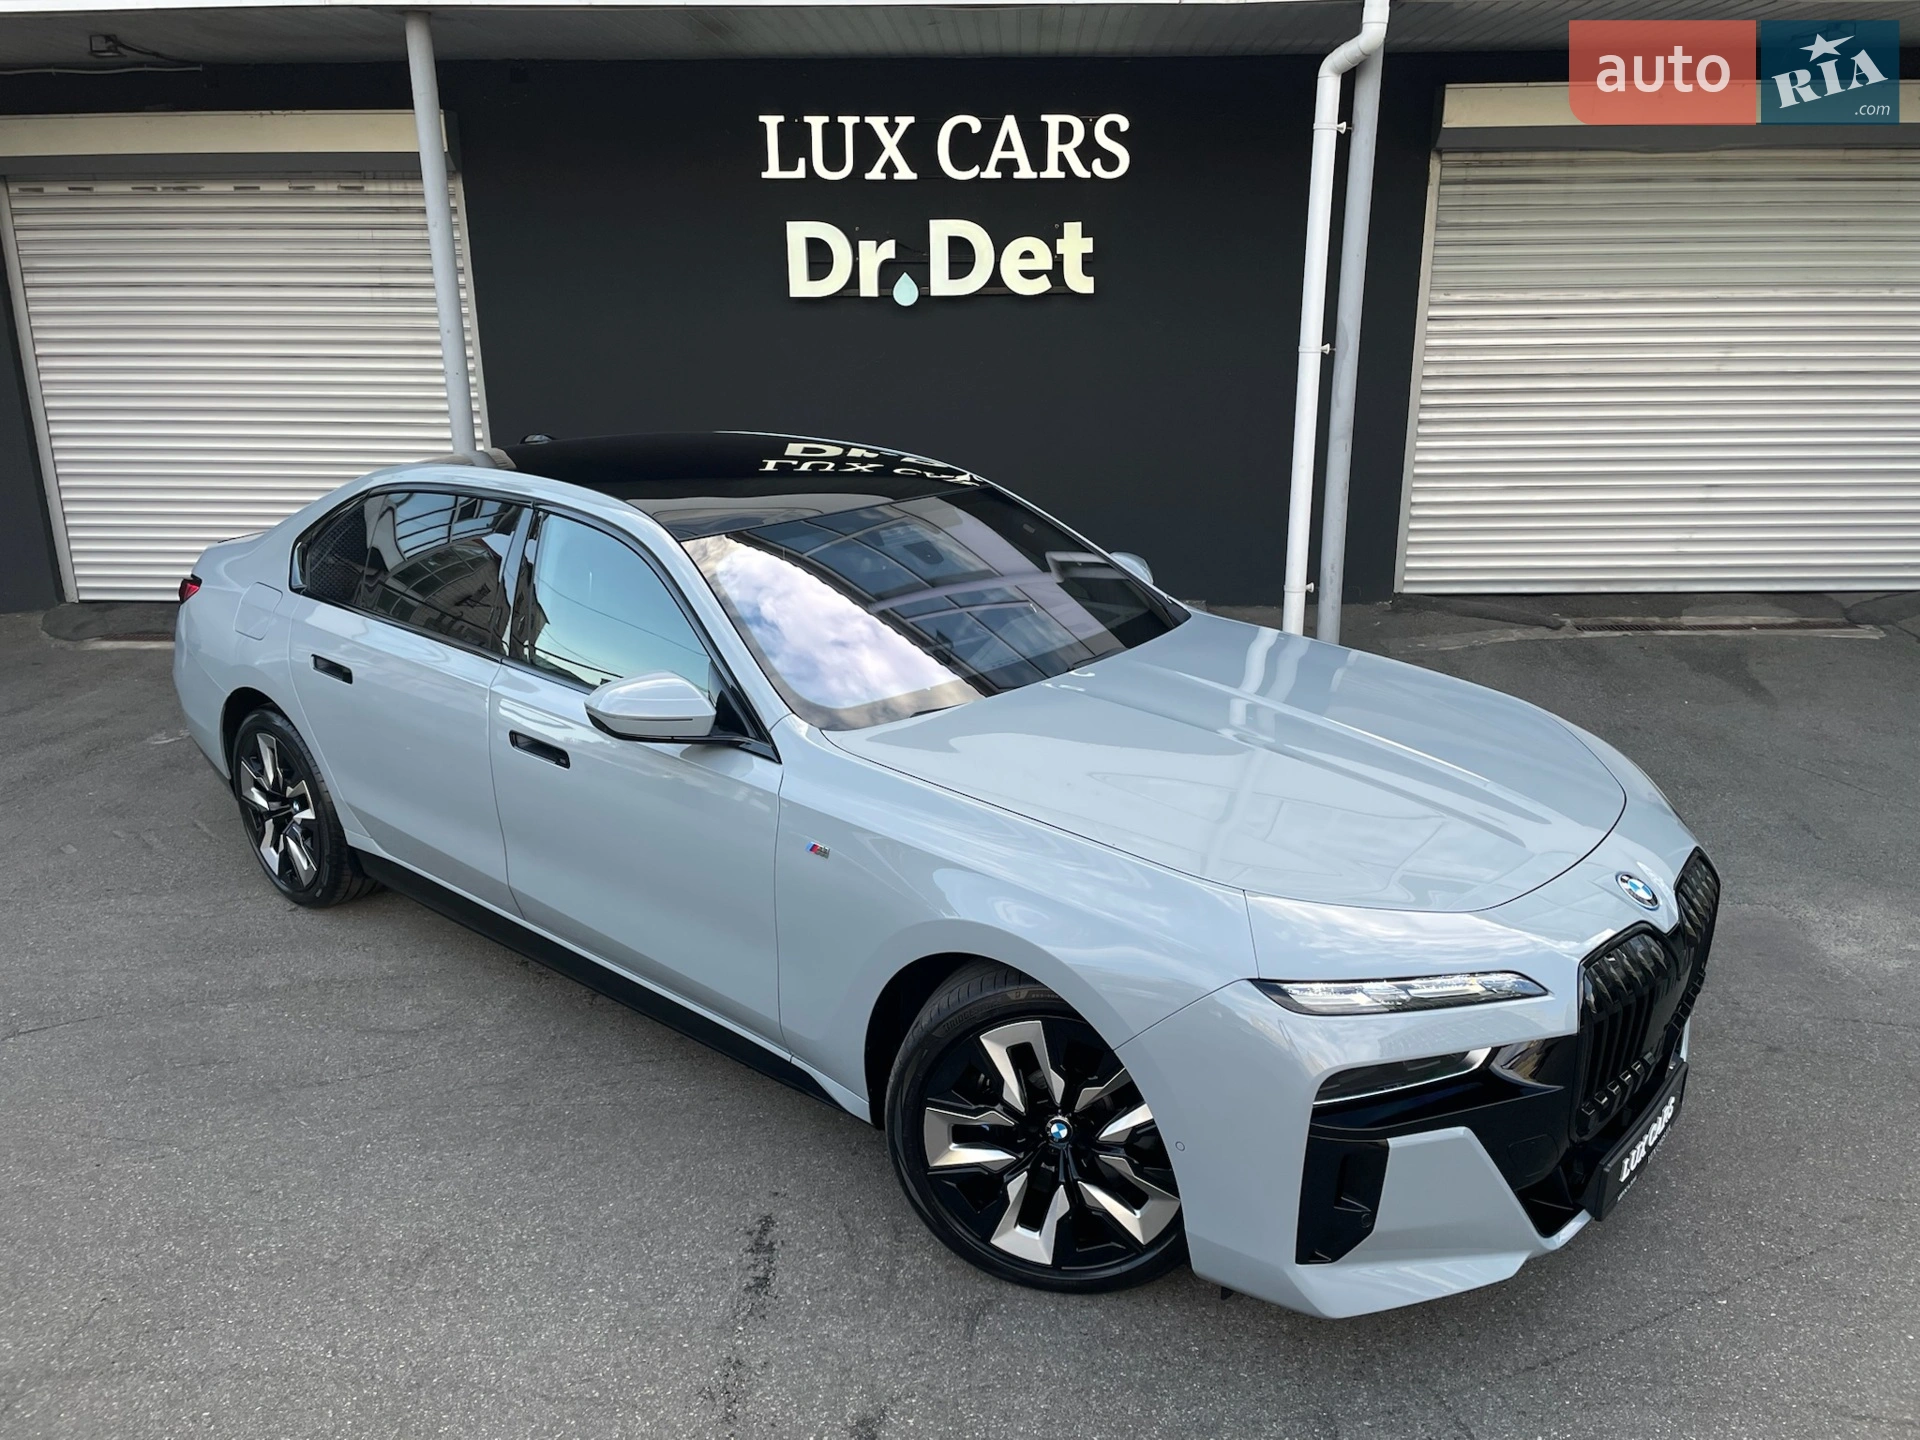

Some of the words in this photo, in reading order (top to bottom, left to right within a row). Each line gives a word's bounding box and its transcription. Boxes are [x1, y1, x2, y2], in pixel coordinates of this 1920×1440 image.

[758, 114, 918, 180] LUX
[936, 113, 1131, 180] CARS
[1619, 1133, 1649, 1182] LUX
[1648, 1096, 1676, 1147] CARS
